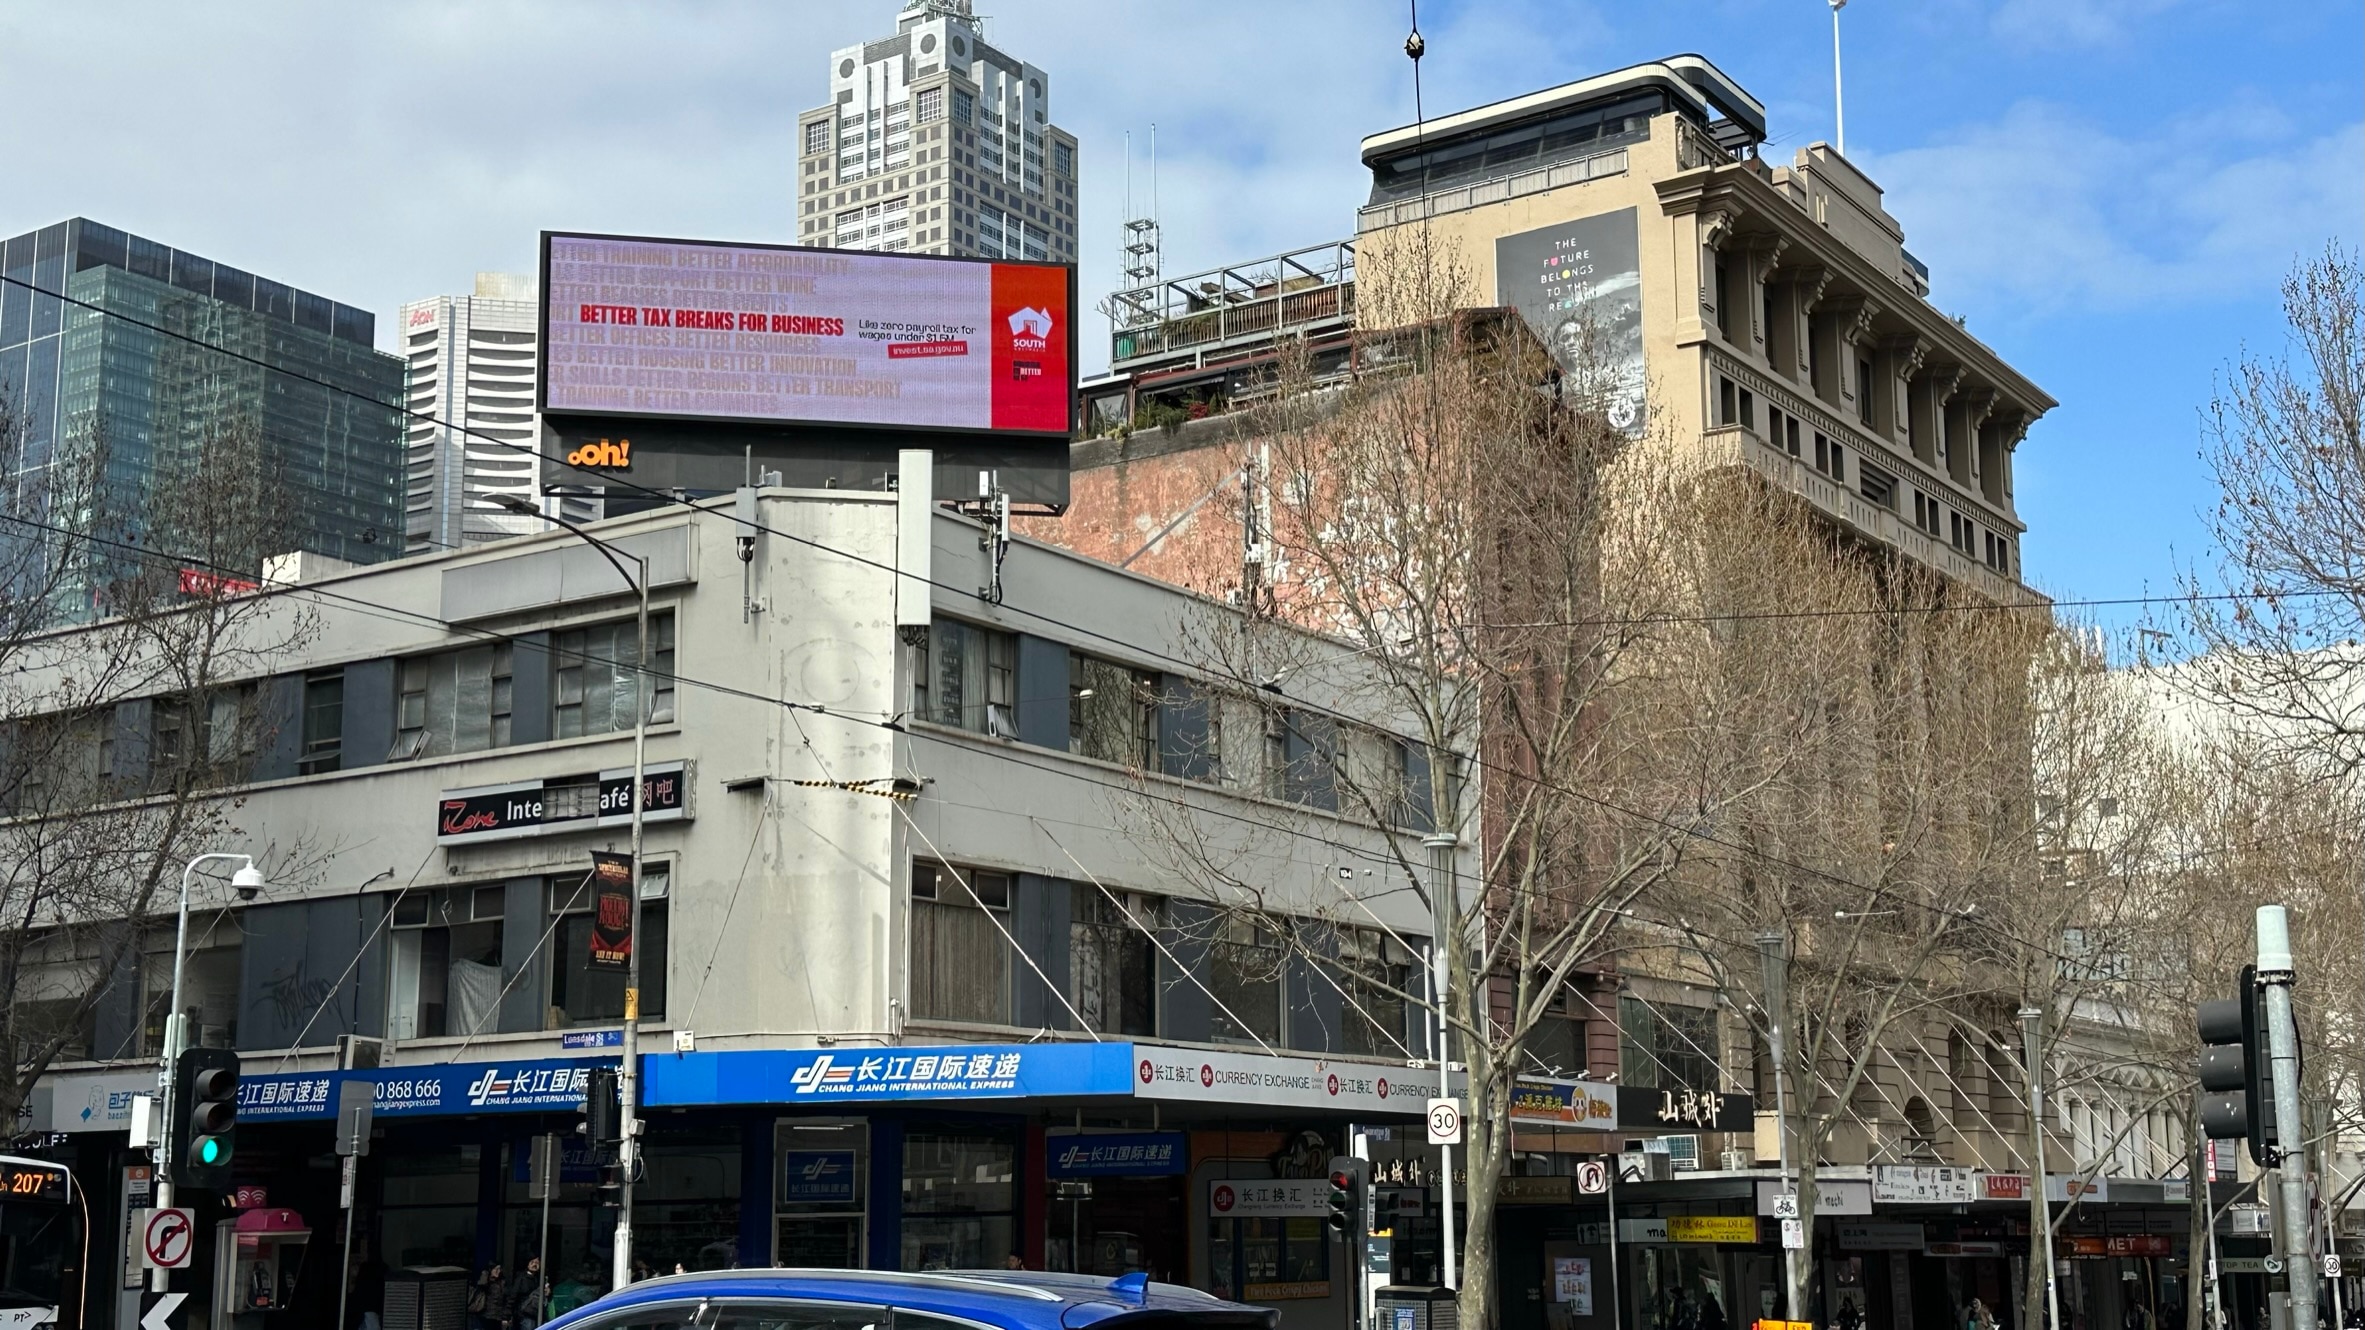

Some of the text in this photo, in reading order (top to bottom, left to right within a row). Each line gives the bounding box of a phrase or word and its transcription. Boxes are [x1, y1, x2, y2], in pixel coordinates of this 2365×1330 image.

[1555, 237, 1577, 250] THE
[677, 250, 733, 269] BETTER
[715, 271, 772, 293] BETTER
[1547, 287, 1561, 298] TO
[580, 304, 638, 325] BETTER
[642, 307, 671, 327] TAX
[675, 309, 735, 330] BREAKS
[738, 313, 768, 332] FOR
[771, 314, 844, 336] BUSINESS
[880, 322, 904, 331] zero
[906, 323, 941, 335] payroll
[943, 325, 959, 334] tax
[961, 325, 977, 335] for
[610, 326, 671, 348] OFFICES
[675, 330, 731, 350] BETTER
[1013, 338, 1046, 349] SOUTH
[709, 351, 764, 372] BETTER
[768, 355, 857, 377] INNOVATION
[755, 374, 811, 395] BETTER
[815, 377, 901, 398] TRANSPORT
[857, 1053, 1022, 1082] 长江国际速递
[1155, 1064, 1195, 1083] 长江换汇
[818, 1080, 1015, 1093] CHANG JIANG INTERNATIONAL EXPRESS
[1215, 1070, 1310, 1089] CURRENCY EXCHANGE
[1340, 1079, 1373, 1094] 长江换汇
[387, 1080, 412, 1099] 868
[415, 1079, 441, 1098] 666
[1389, 1083, 1429, 1098] CURRENCY
[486, 1098, 510, 1106] CHANG
[511, 1096, 533, 1105] JIANG
[1433, 1113, 1455, 1129] 30
[1090, 1144, 1172, 1161] 长江国际速递
[13, 1172, 43, 1193] 207
[1242, 1187, 1302, 1202] 长江换汇
[2242, 1261, 2259, 1269] TEA
